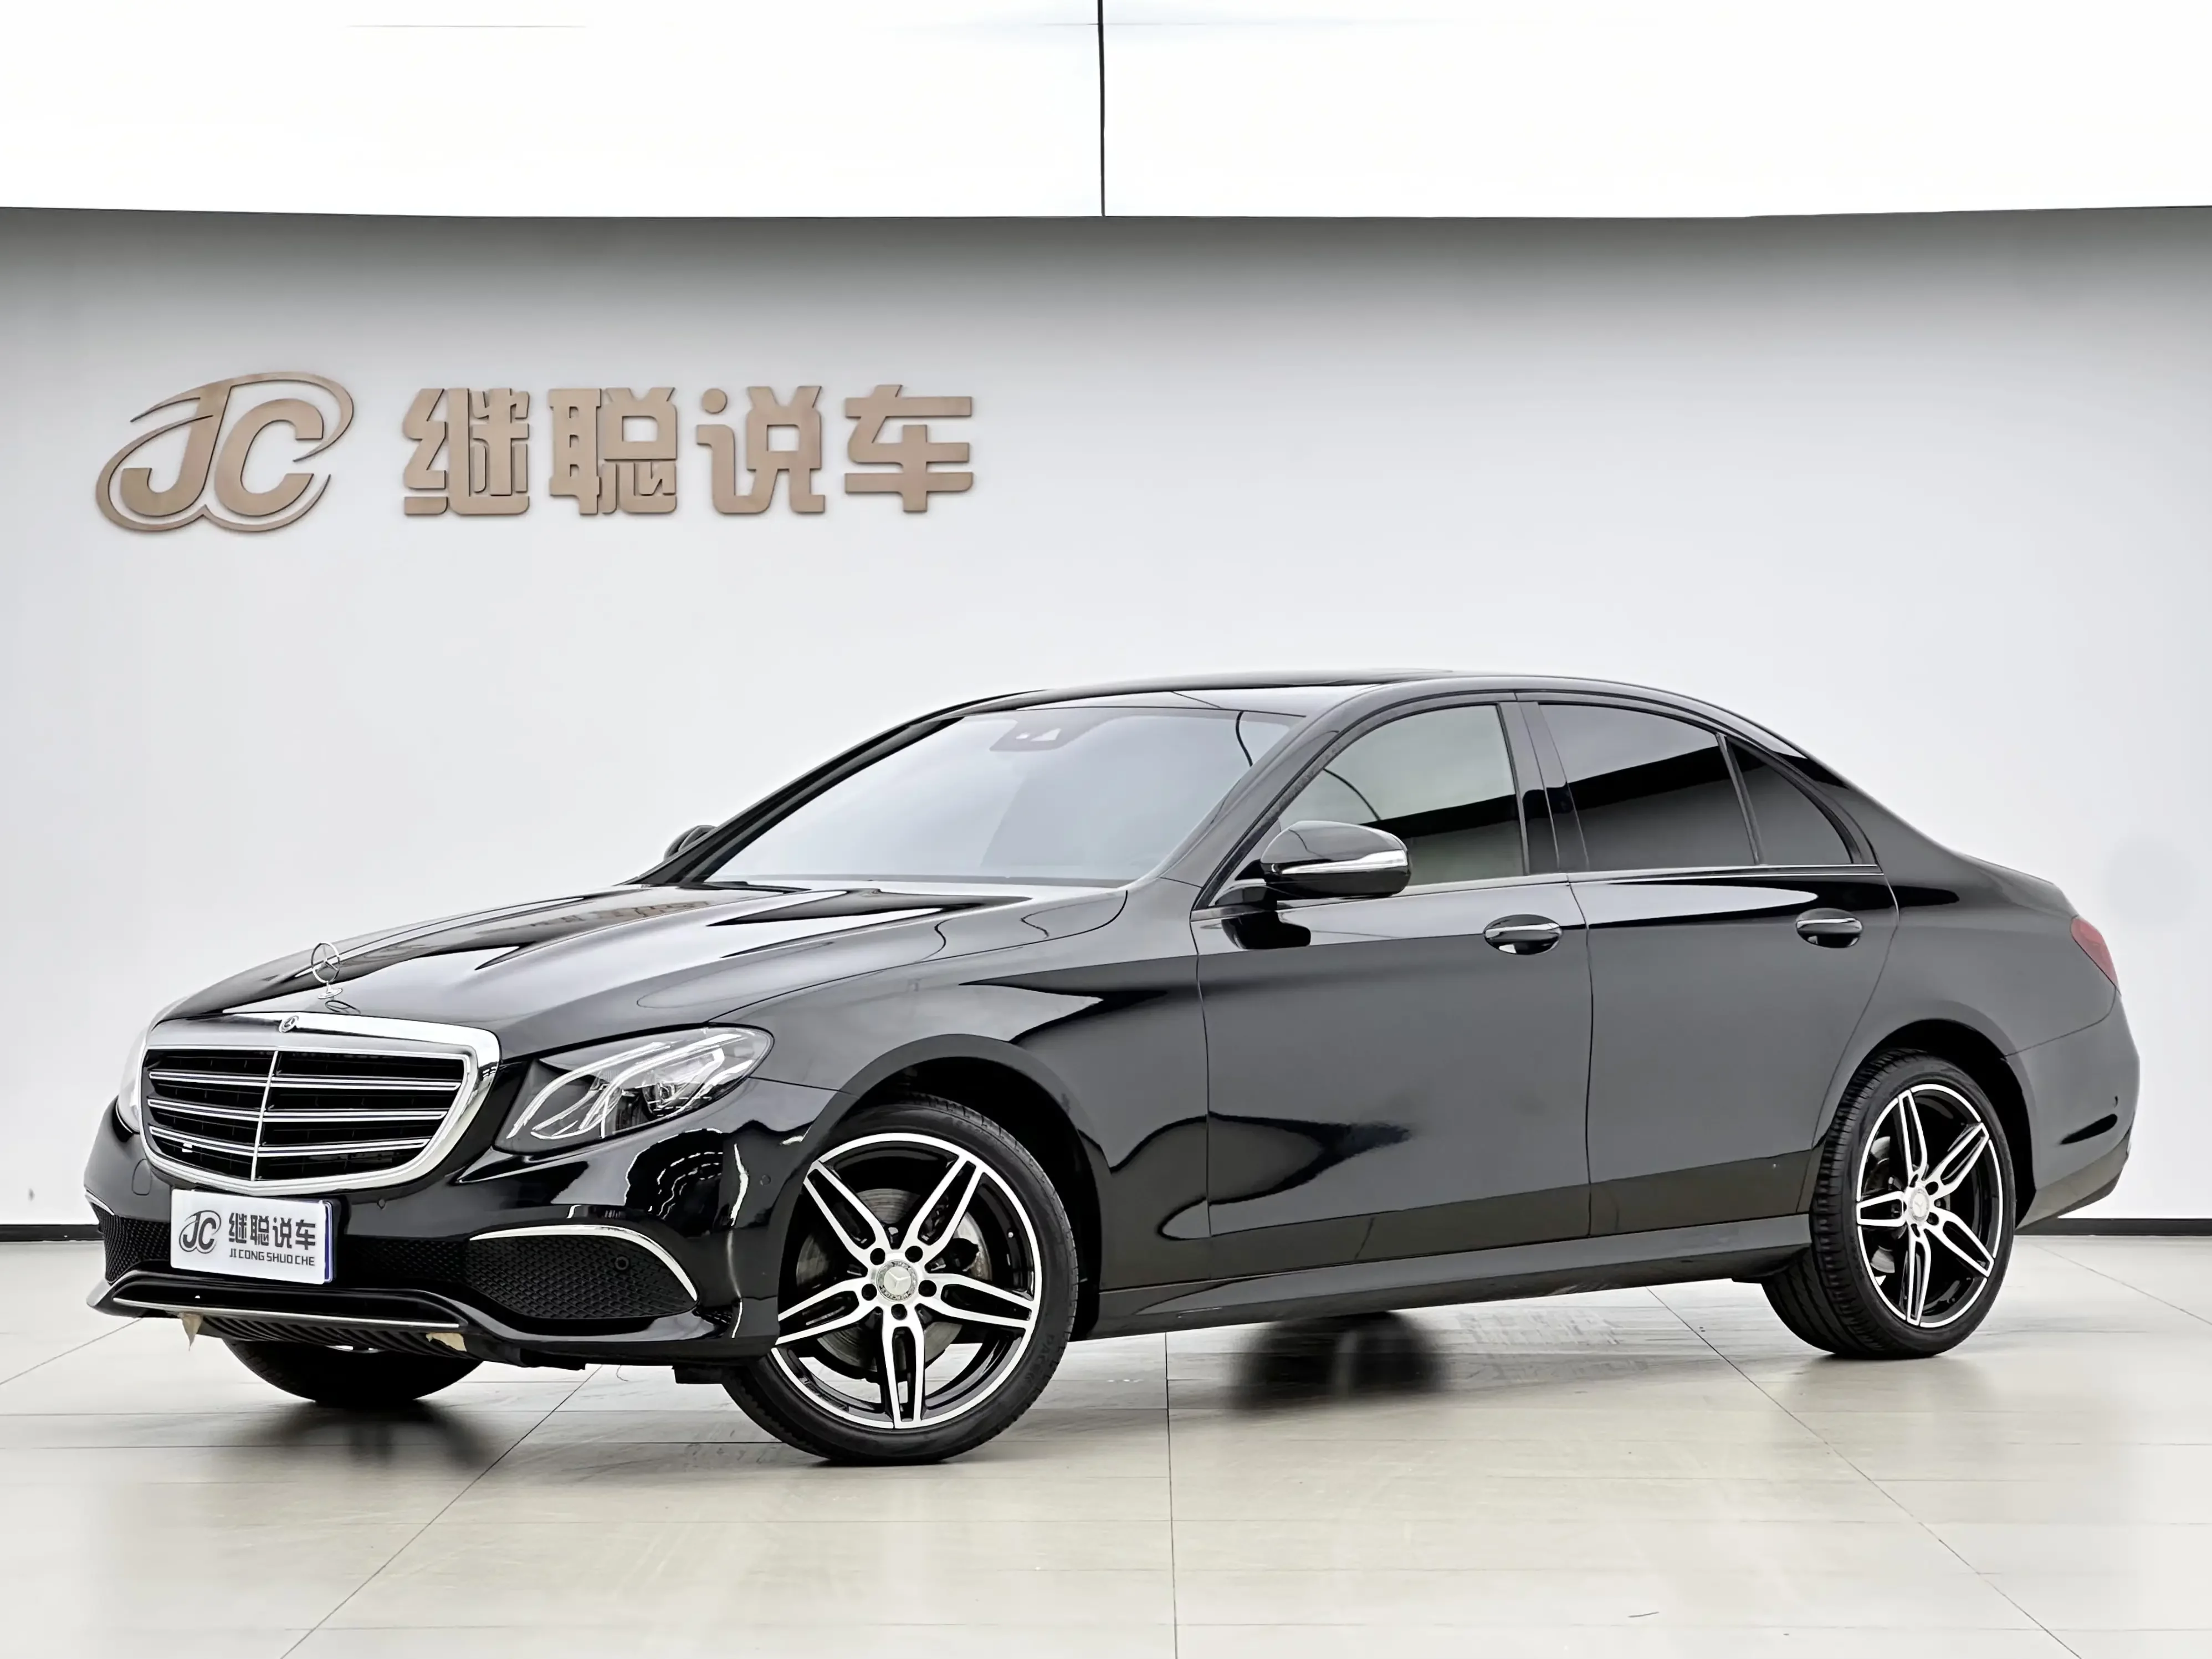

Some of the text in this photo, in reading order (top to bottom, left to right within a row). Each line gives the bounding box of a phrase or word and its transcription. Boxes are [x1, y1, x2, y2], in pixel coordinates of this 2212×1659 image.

[403, 384, 974, 516] 继聪说车
[228, 1212, 316, 1250] 继聪说车
[238, 1250, 264, 1261] CONG
[267, 1252, 293, 1264] SHUO
[295, 1256, 315, 1266] CHE
